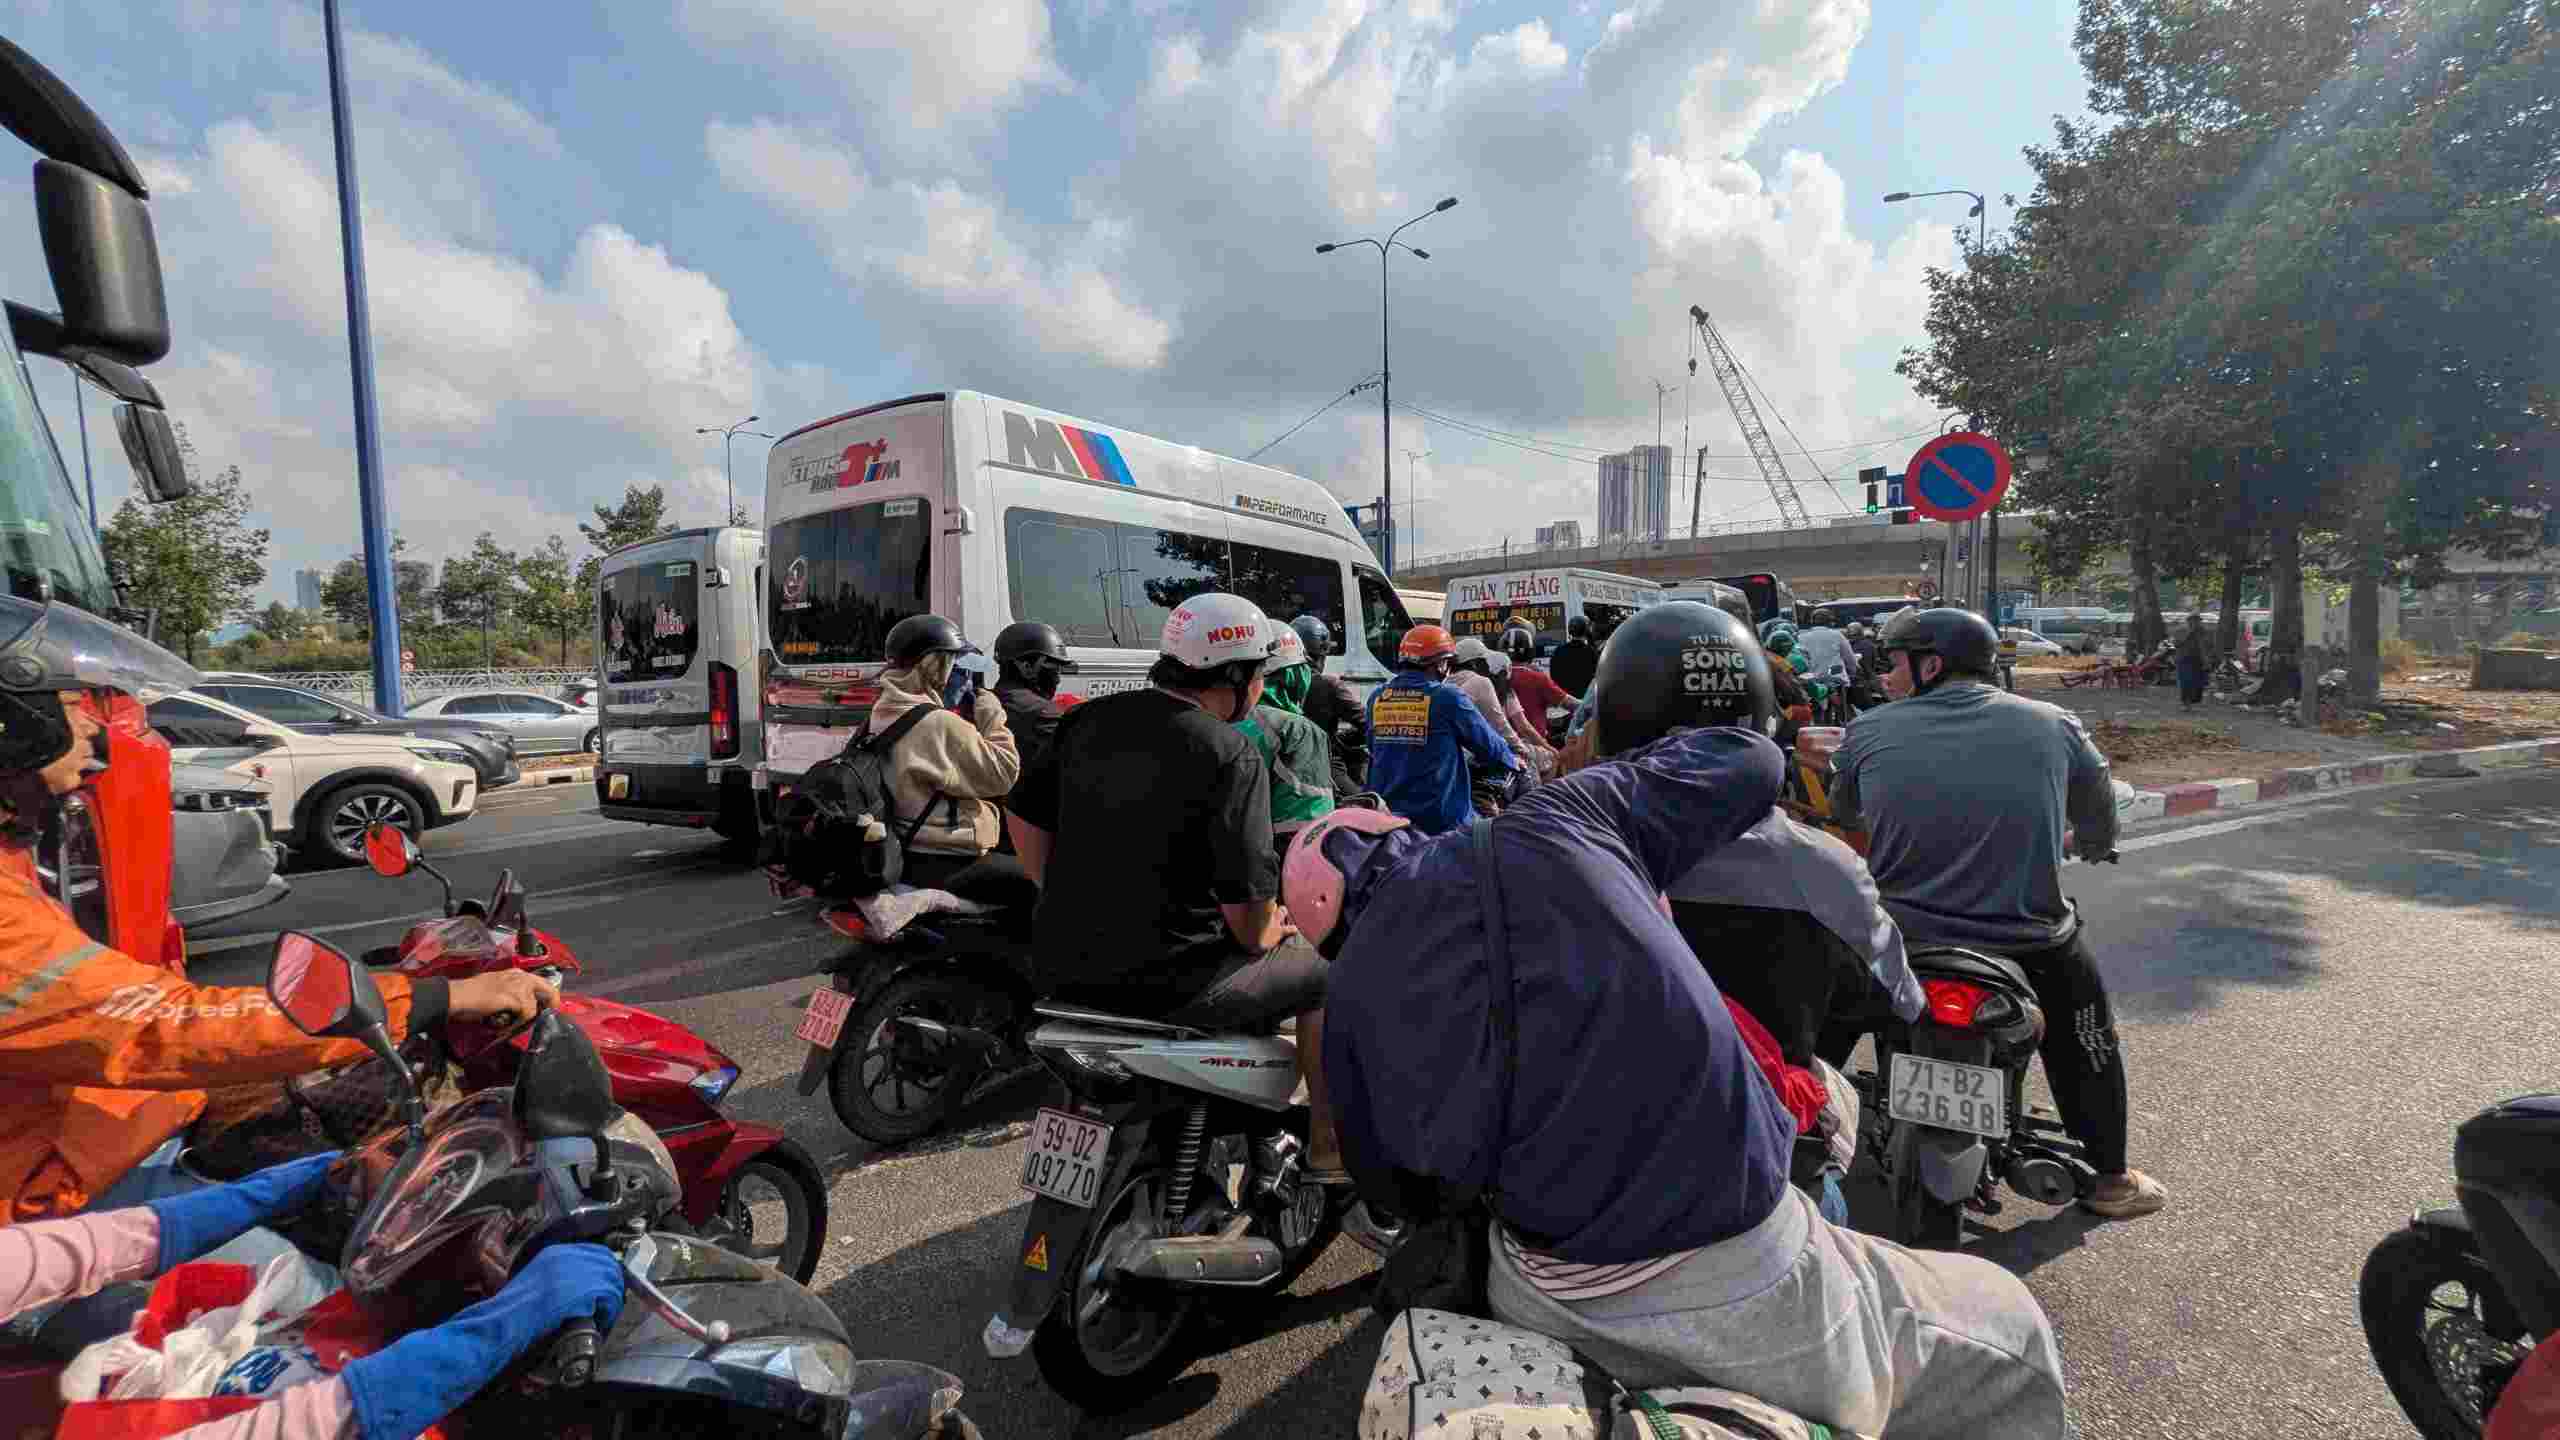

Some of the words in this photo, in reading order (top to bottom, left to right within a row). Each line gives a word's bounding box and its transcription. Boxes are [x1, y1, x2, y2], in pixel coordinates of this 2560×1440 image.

[802, 669, 861, 680] FORD
[1904, 1060, 1985, 1099] 71-B2
[1026, 1151, 1095, 1201] 097.70
